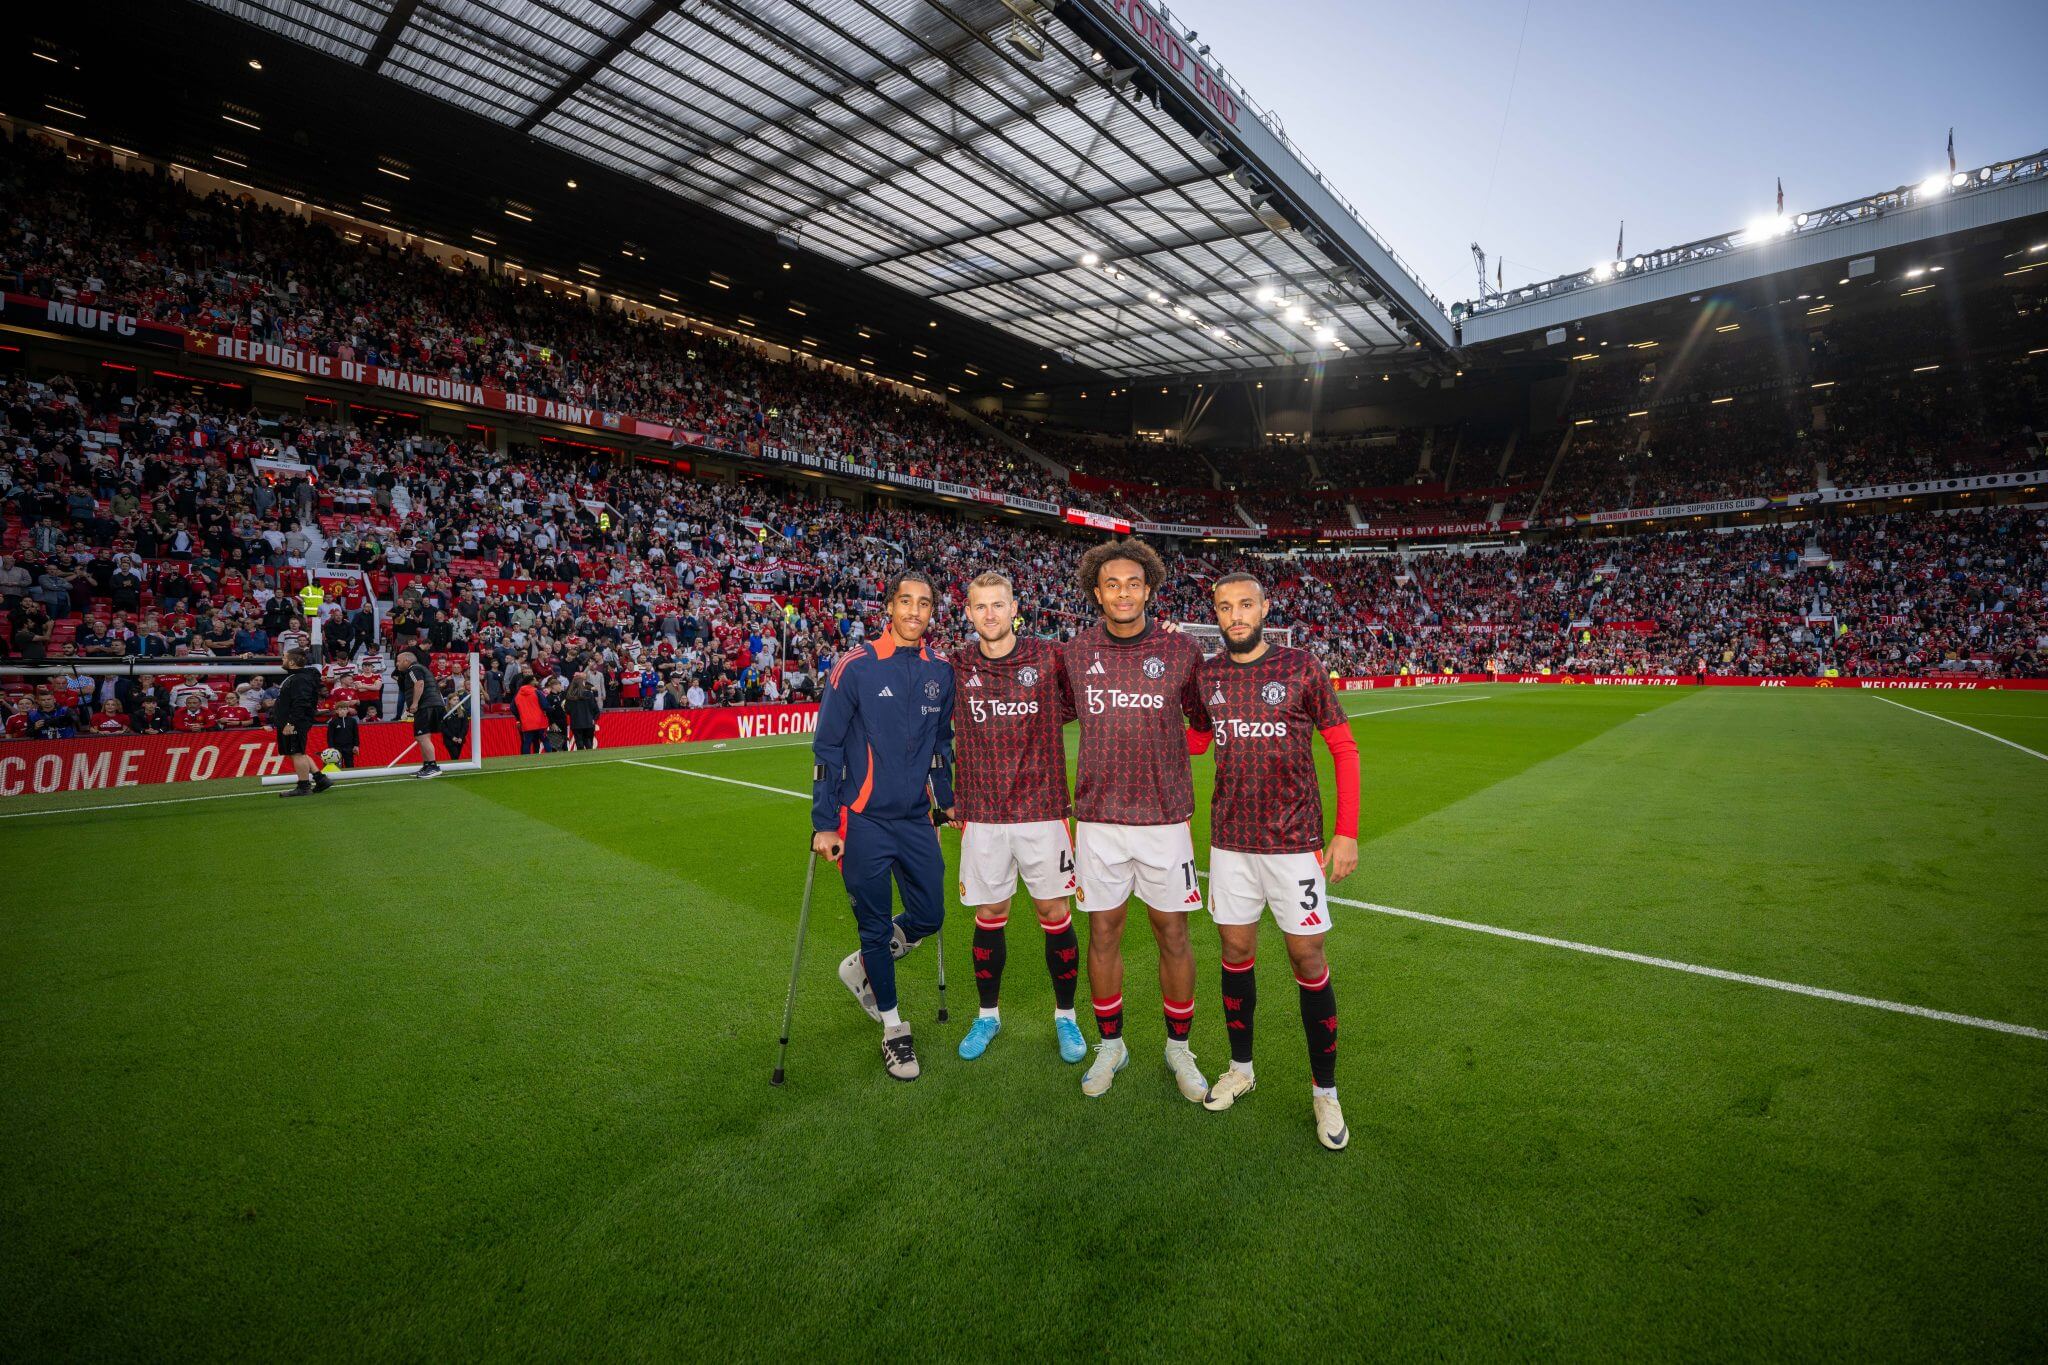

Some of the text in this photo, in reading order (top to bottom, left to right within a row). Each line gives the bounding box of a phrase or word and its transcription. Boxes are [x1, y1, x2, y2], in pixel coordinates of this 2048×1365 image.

[1196, 63, 1237, 124] END
[47, 300, 137, 336] MUFC
[341, 360, 367, 383] OF
[762, 445, 779, 459] FEB
[824, 458, 838, 471] THE
[840, 461, 876, 478] FLOWERS
[877, 469, 887, 480] OF
[888, 472, 933, 490] MANCHESTER
[956, 485, 969, 496] LAW
[1597, 511, 1628, 521] RAINBOW
[1630, 509, 1655, 518] DEVILS
[1687, 502, 1734, 513] SUPPORTERS
[1735, 500, 1755, 509] CLUB
[1323, 523, 1487, 537] MANCHESTER IS MY HEAVEN
[1215, 680, 1221, 689] 3
[1594, 678, 1678, 686] WELCOME TO TH
[987, 699, 1039, 716] Tezos
[1107, 689, 1164, 709] Tezos
[737, 711, 819, 738] WELCOM
[1228, 719, 1287, 738] Tezos
[0, 742, 286, 797] COME TO TH
[1060, 850, 1075, 874] 4
[1182, 859, 1198, 890] 11
[1298, 878, 1319, 910] 3
